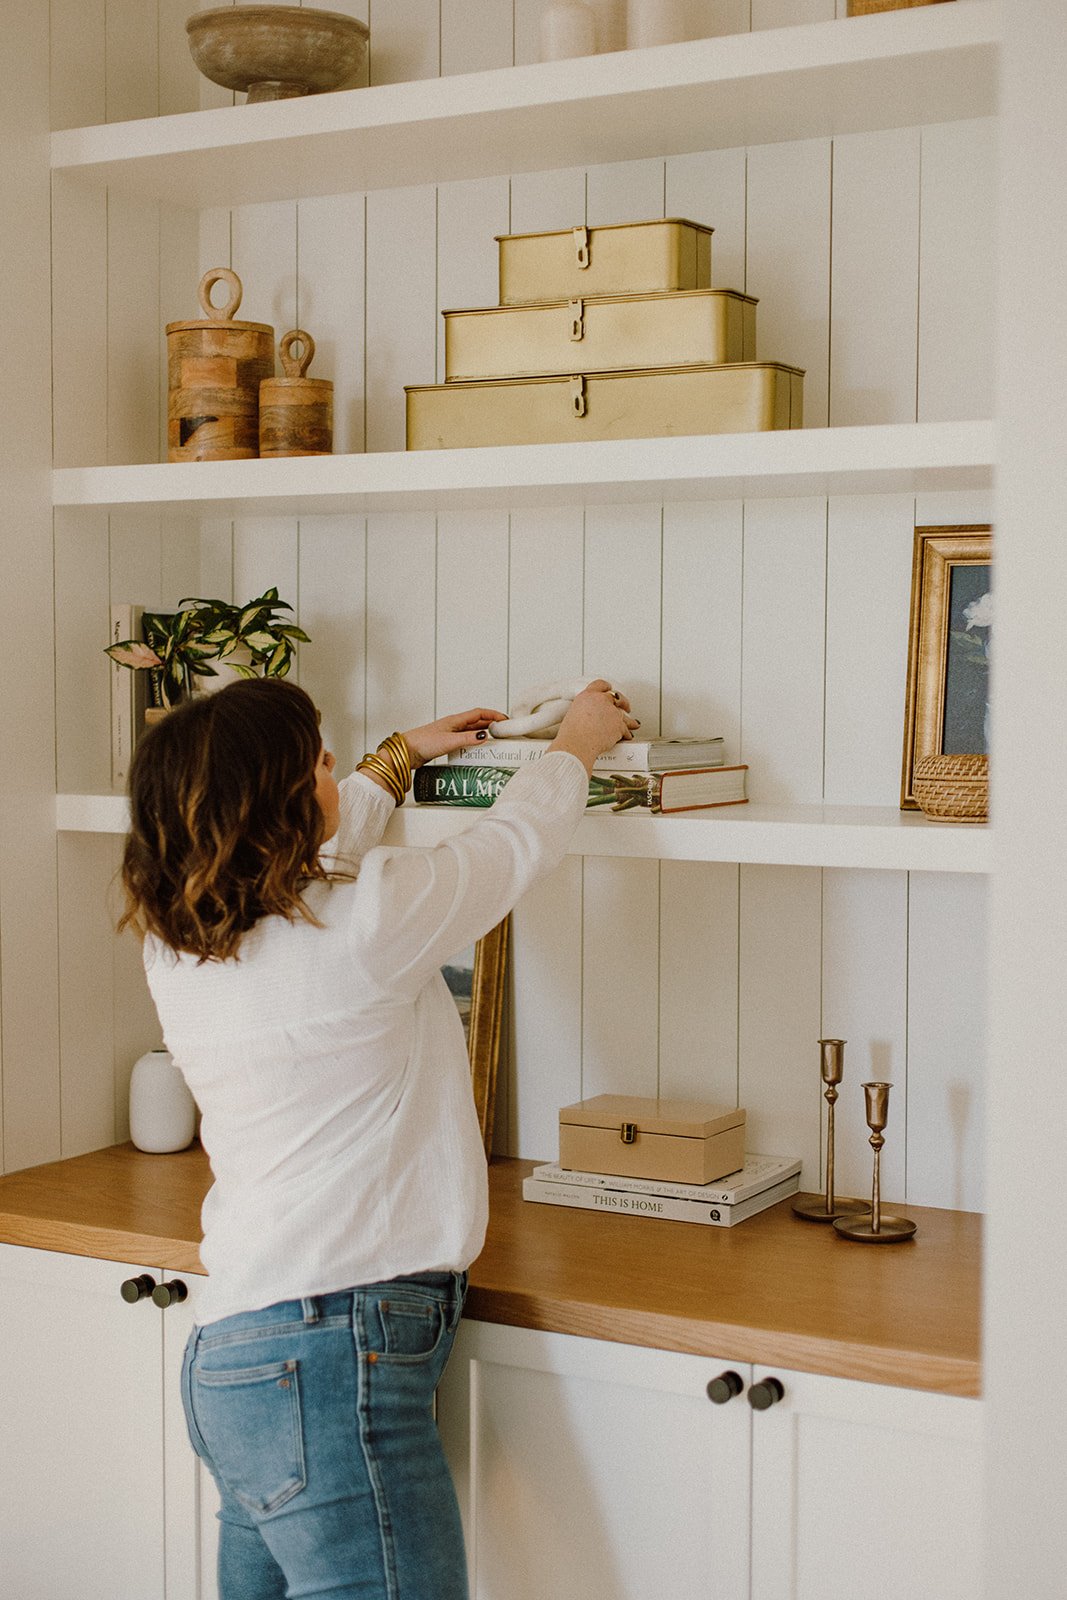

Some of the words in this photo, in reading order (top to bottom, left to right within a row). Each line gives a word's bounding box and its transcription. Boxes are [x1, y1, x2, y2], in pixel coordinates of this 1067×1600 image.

[459, 748, 488, 760] Pacific
[489, 749, 522, 761] Natural
[593, 1195, 618, 1207] THIS
[620, 1198, 629, 1208] IS
[631, 1200, 664, 1213] HOME
